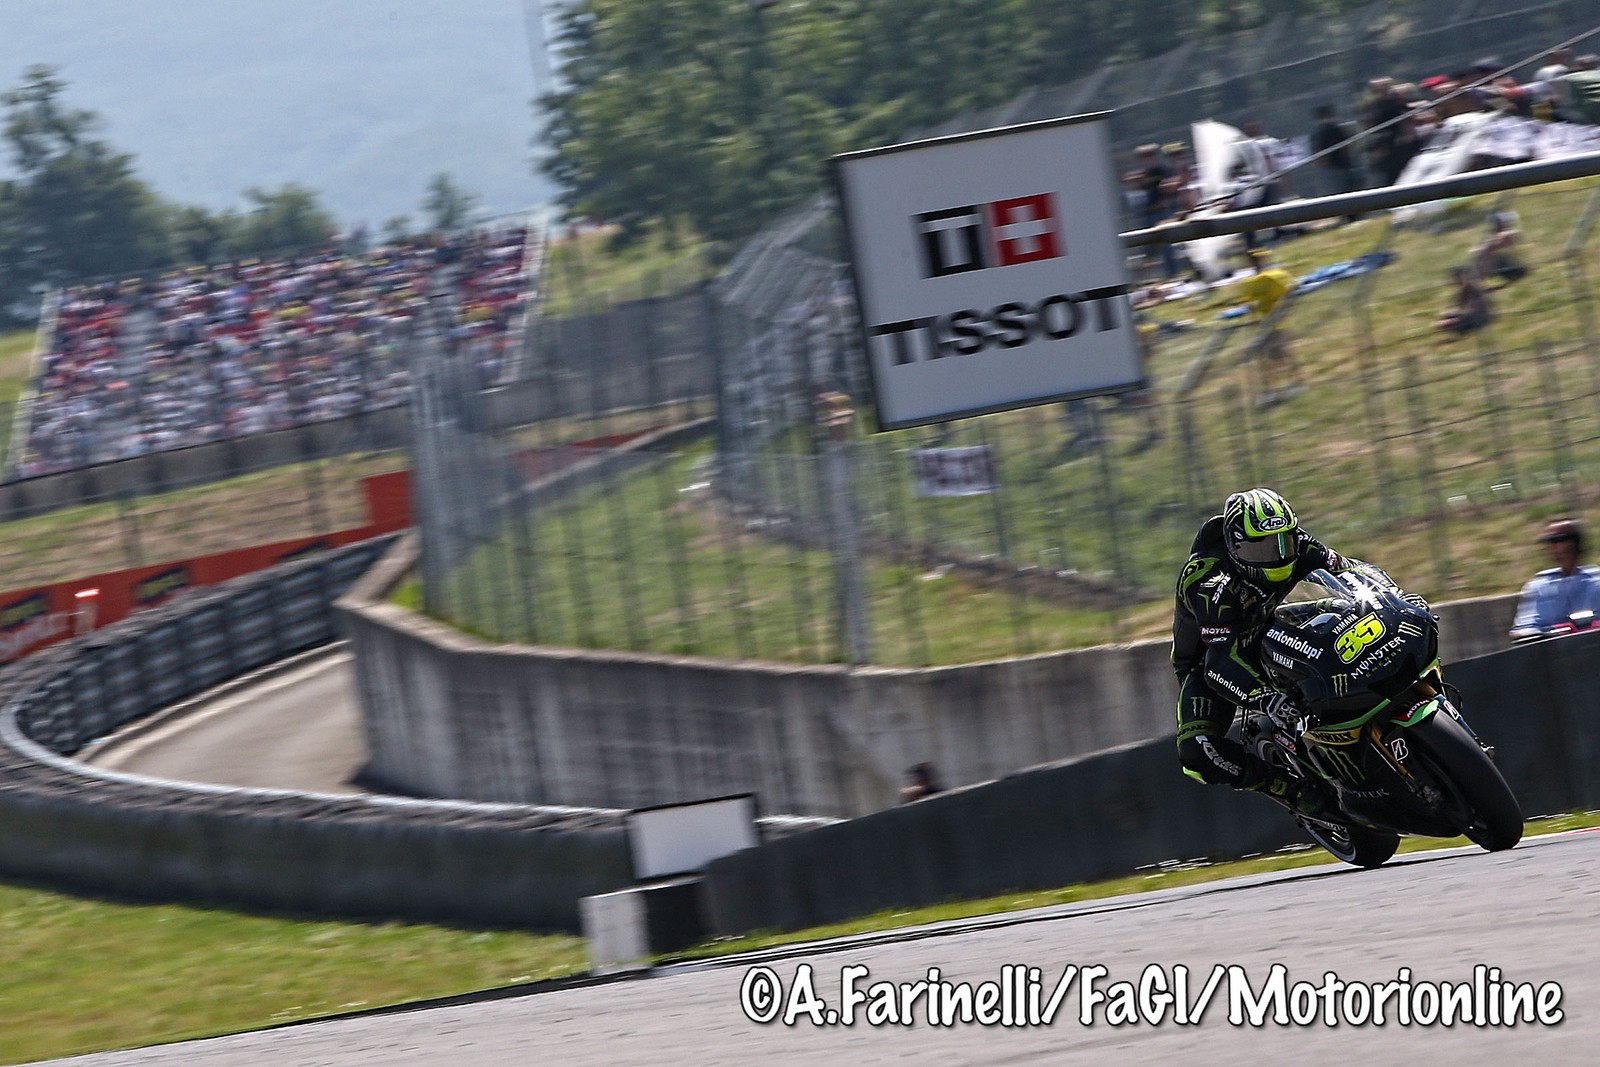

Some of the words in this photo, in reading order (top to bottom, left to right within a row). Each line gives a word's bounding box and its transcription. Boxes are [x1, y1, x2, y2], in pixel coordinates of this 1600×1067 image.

[871, 284, 1129, 366] TISSOT
[1201, 627, 1231, 635] MOTUL
[1331, 613, 1358, 635] YAMAHA
[1334, 612, 1386, 664] 35
[1266, 628, 1324, 660] antoniolupi
[1350, 636, 1406, 680] MONSTER
[1272, 651, 1294, 670] YAMAHA
